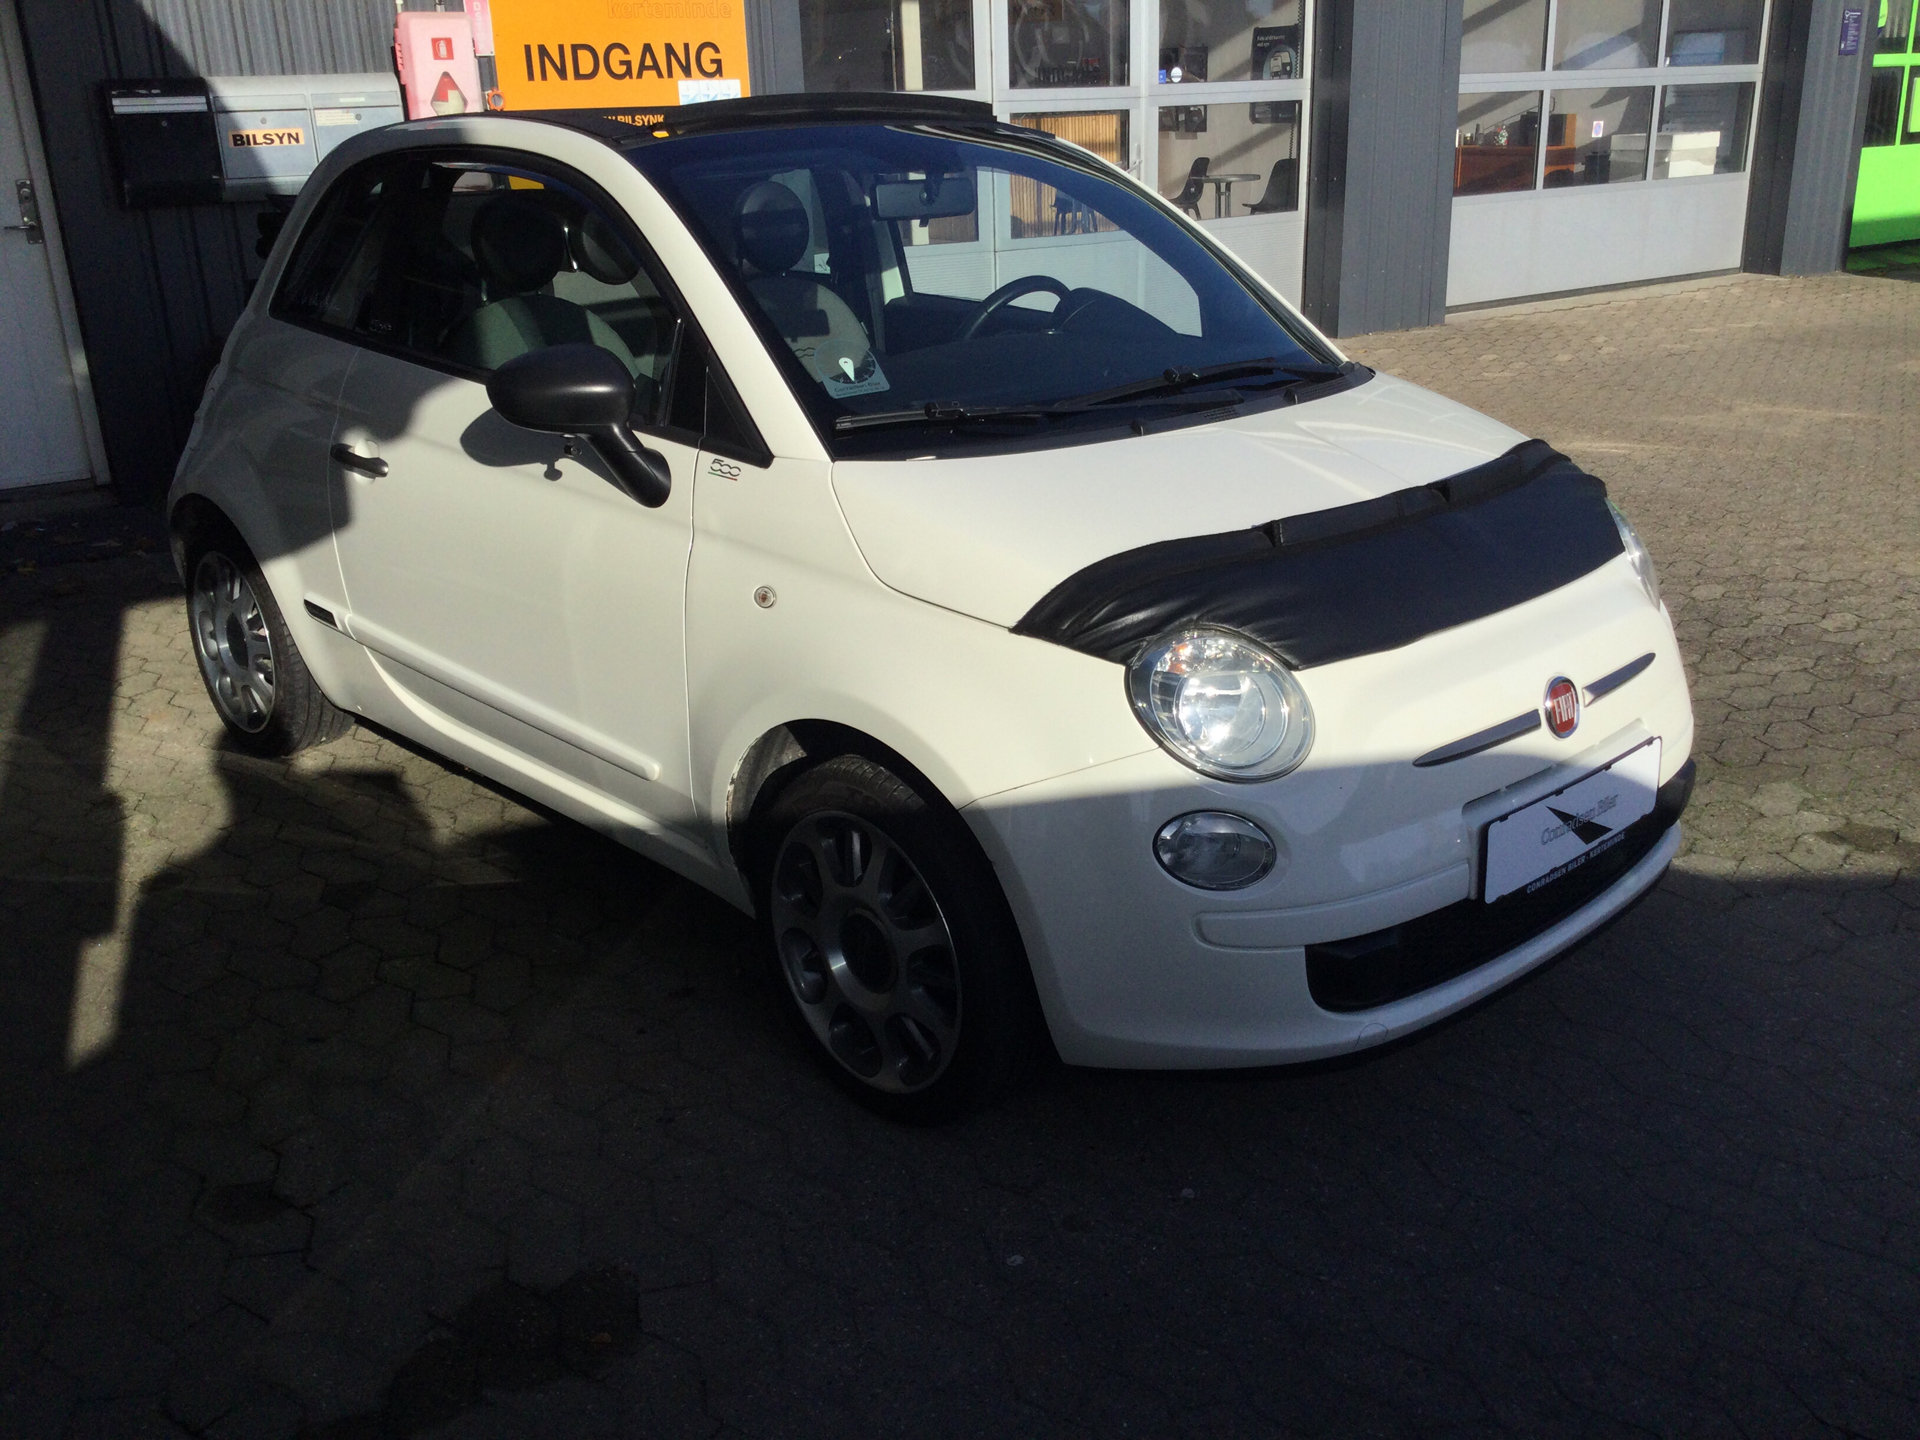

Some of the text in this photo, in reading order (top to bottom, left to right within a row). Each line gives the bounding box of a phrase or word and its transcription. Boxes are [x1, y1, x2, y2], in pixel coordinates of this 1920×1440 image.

[606, 0, 731, 19] kerteminde
[523, 42, 723, 81] INDGANG
[603, 114, 664, 127] BILSYNK
[231, 131, 301, 147] BILSYN
[710, 458, 741, 477] 500
[1553, 687, 1577, 724] FIAT
[1540, 793, 1619, 845] Conradsen Biler
[1526, 831, 1626, 894] CONRADSEN BILER KERTEMINDE
